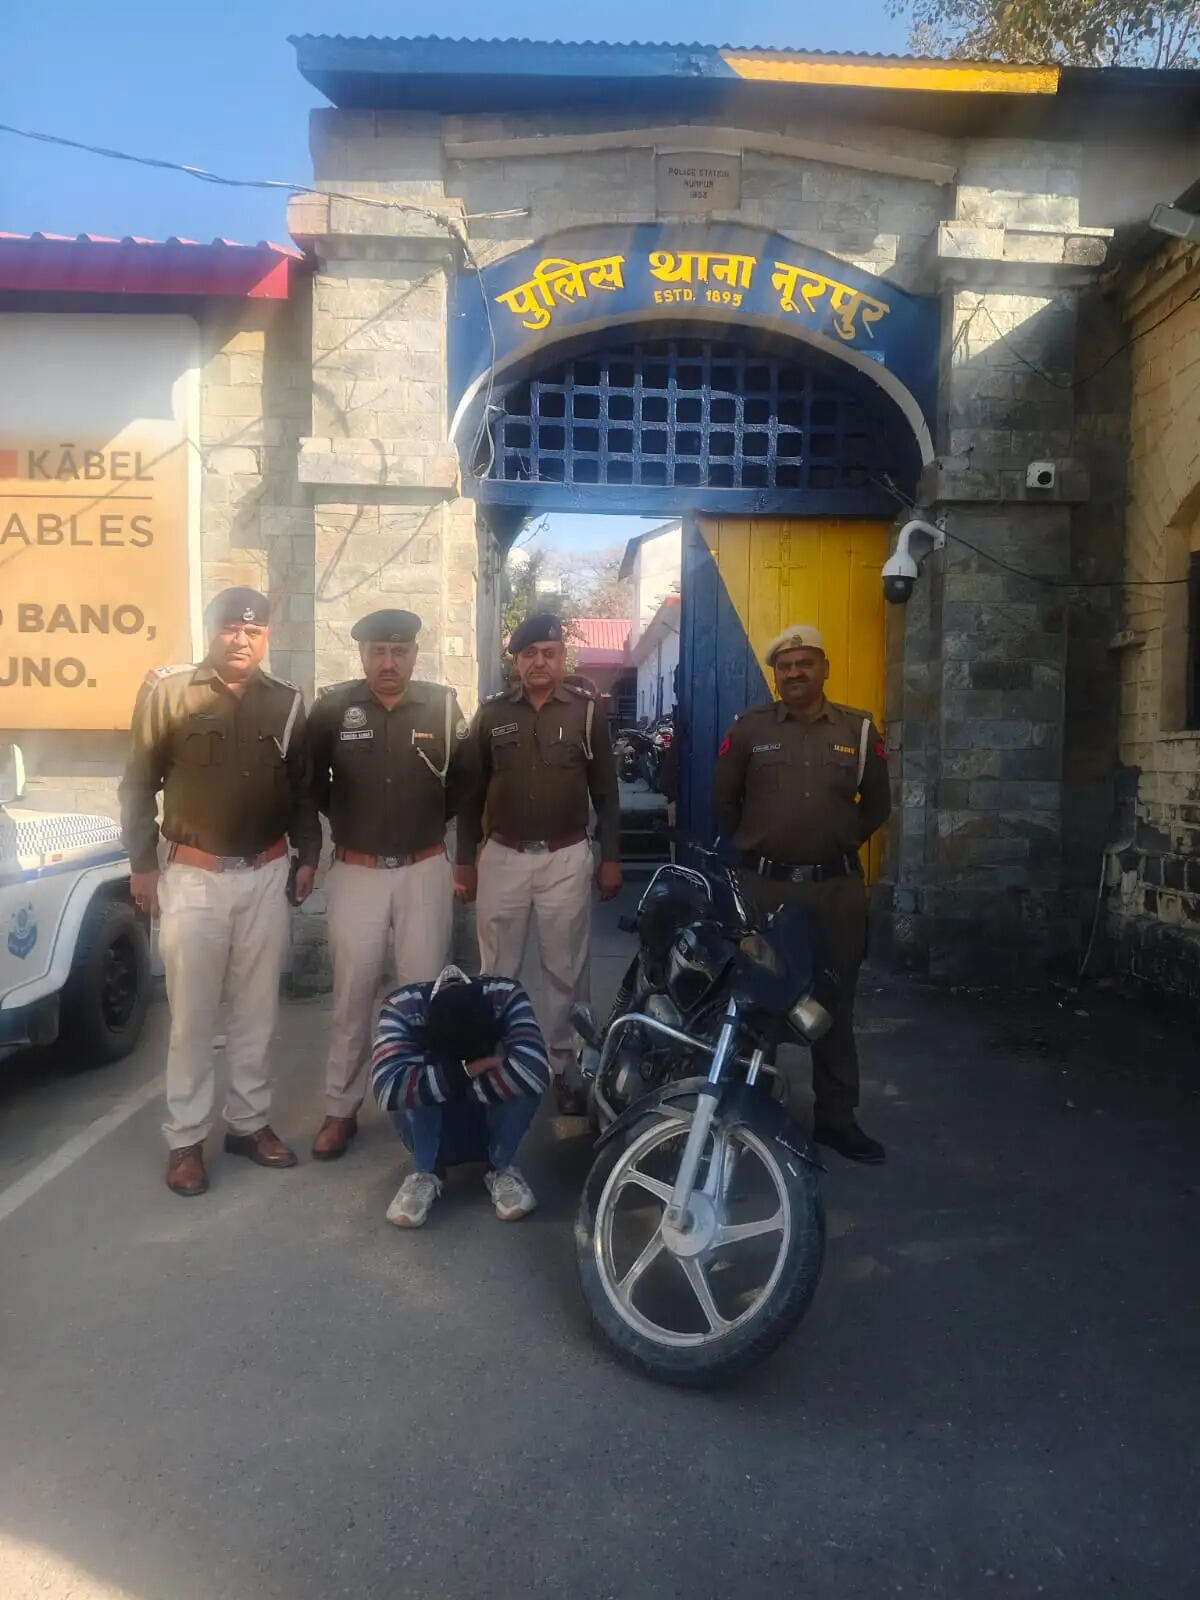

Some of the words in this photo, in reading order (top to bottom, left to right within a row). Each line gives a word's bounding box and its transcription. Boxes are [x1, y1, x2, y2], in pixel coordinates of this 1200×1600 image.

[668, 167, 697, 177] POLICE
[494, 254, 626, 330] पुलिस
[648, 250, 757, 289] थाना
[771, 261, 891, 340] नूरपुर
[653, 288, 696, 304] ESTD.
[18, 603, 157, 641] BANO,
